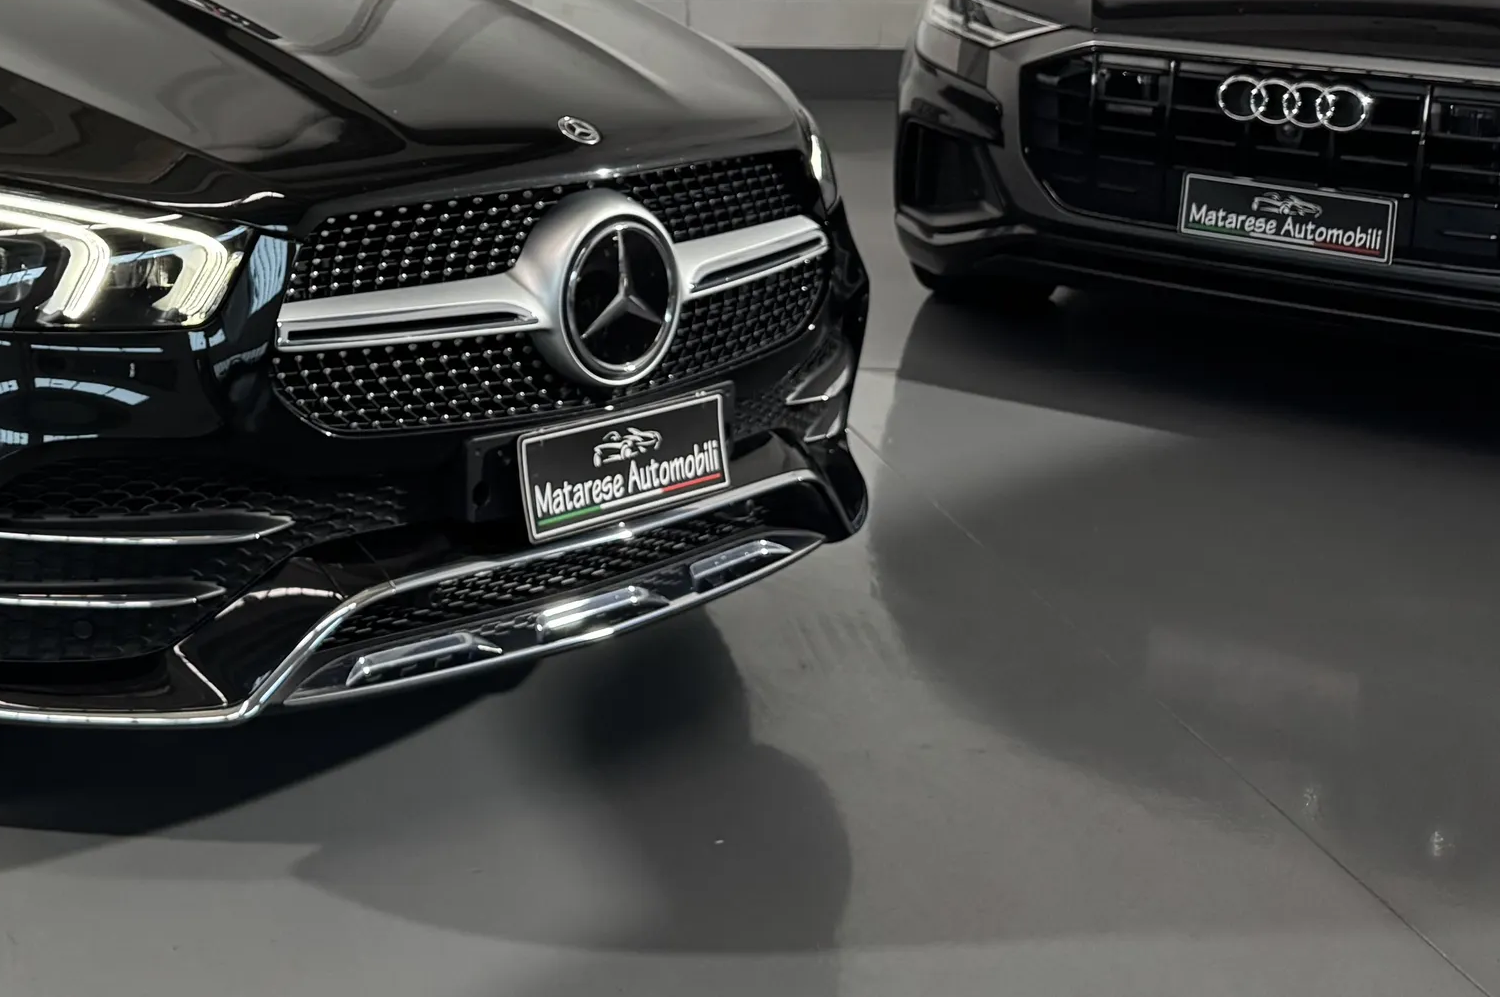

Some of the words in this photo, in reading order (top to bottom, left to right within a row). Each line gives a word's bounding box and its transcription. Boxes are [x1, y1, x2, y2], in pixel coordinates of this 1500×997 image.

[1189, 202, 1277, 234] Matarese
[1281, 216, 1382, 250] Automobili
[534, 473, 625, 518] Matarese
[627, 439, 721, 493] Automobili
